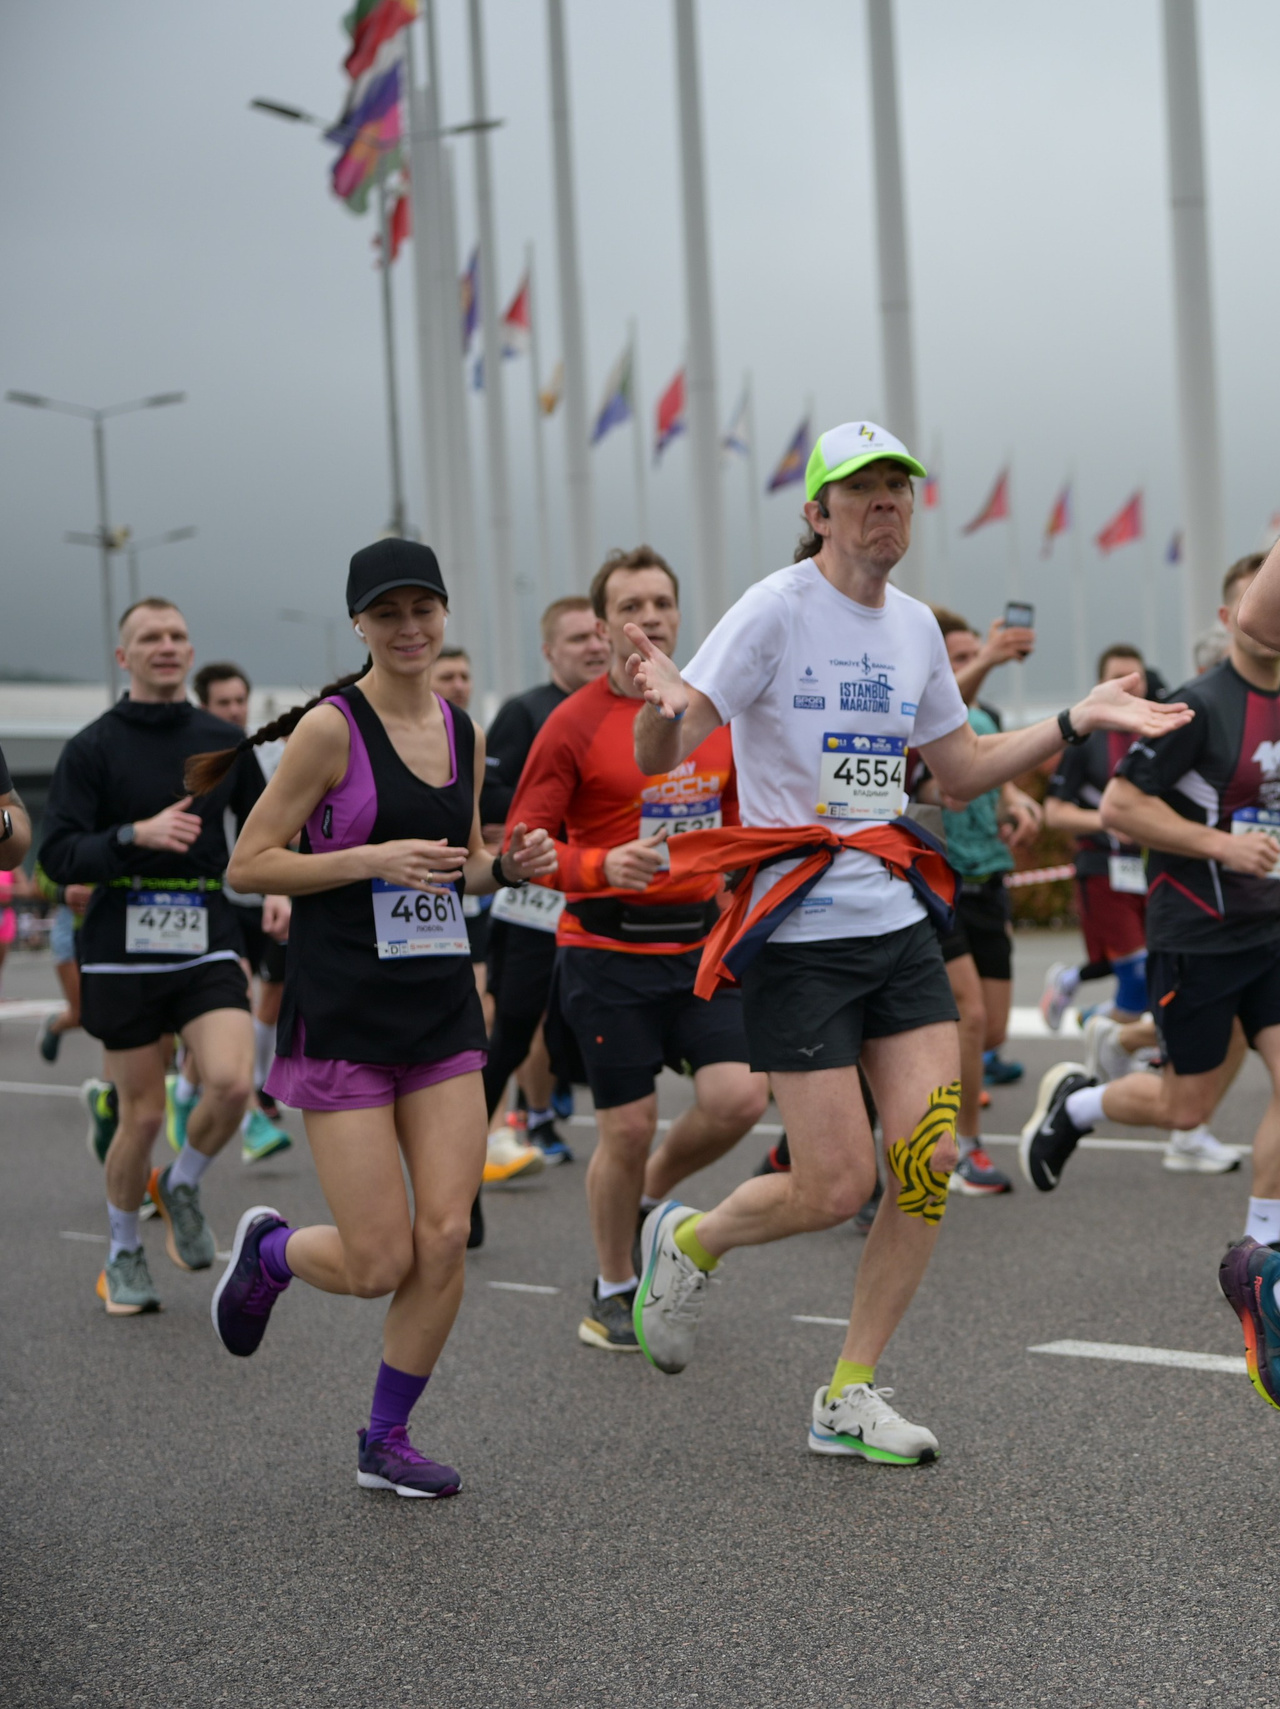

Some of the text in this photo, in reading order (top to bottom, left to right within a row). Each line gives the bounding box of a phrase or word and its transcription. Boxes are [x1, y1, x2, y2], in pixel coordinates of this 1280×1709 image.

[840, 698, 890, 713] MARATONU
[833, 757, 902, 789] 4554
[641, 775, 720, 802] SOCHI
[853, 789, 890, 798] ВЛАДИМИР
[138, 907, 200, 931] 4732
[390, 894, 457, 923] 4661
[390, 945, 399, 955] D
